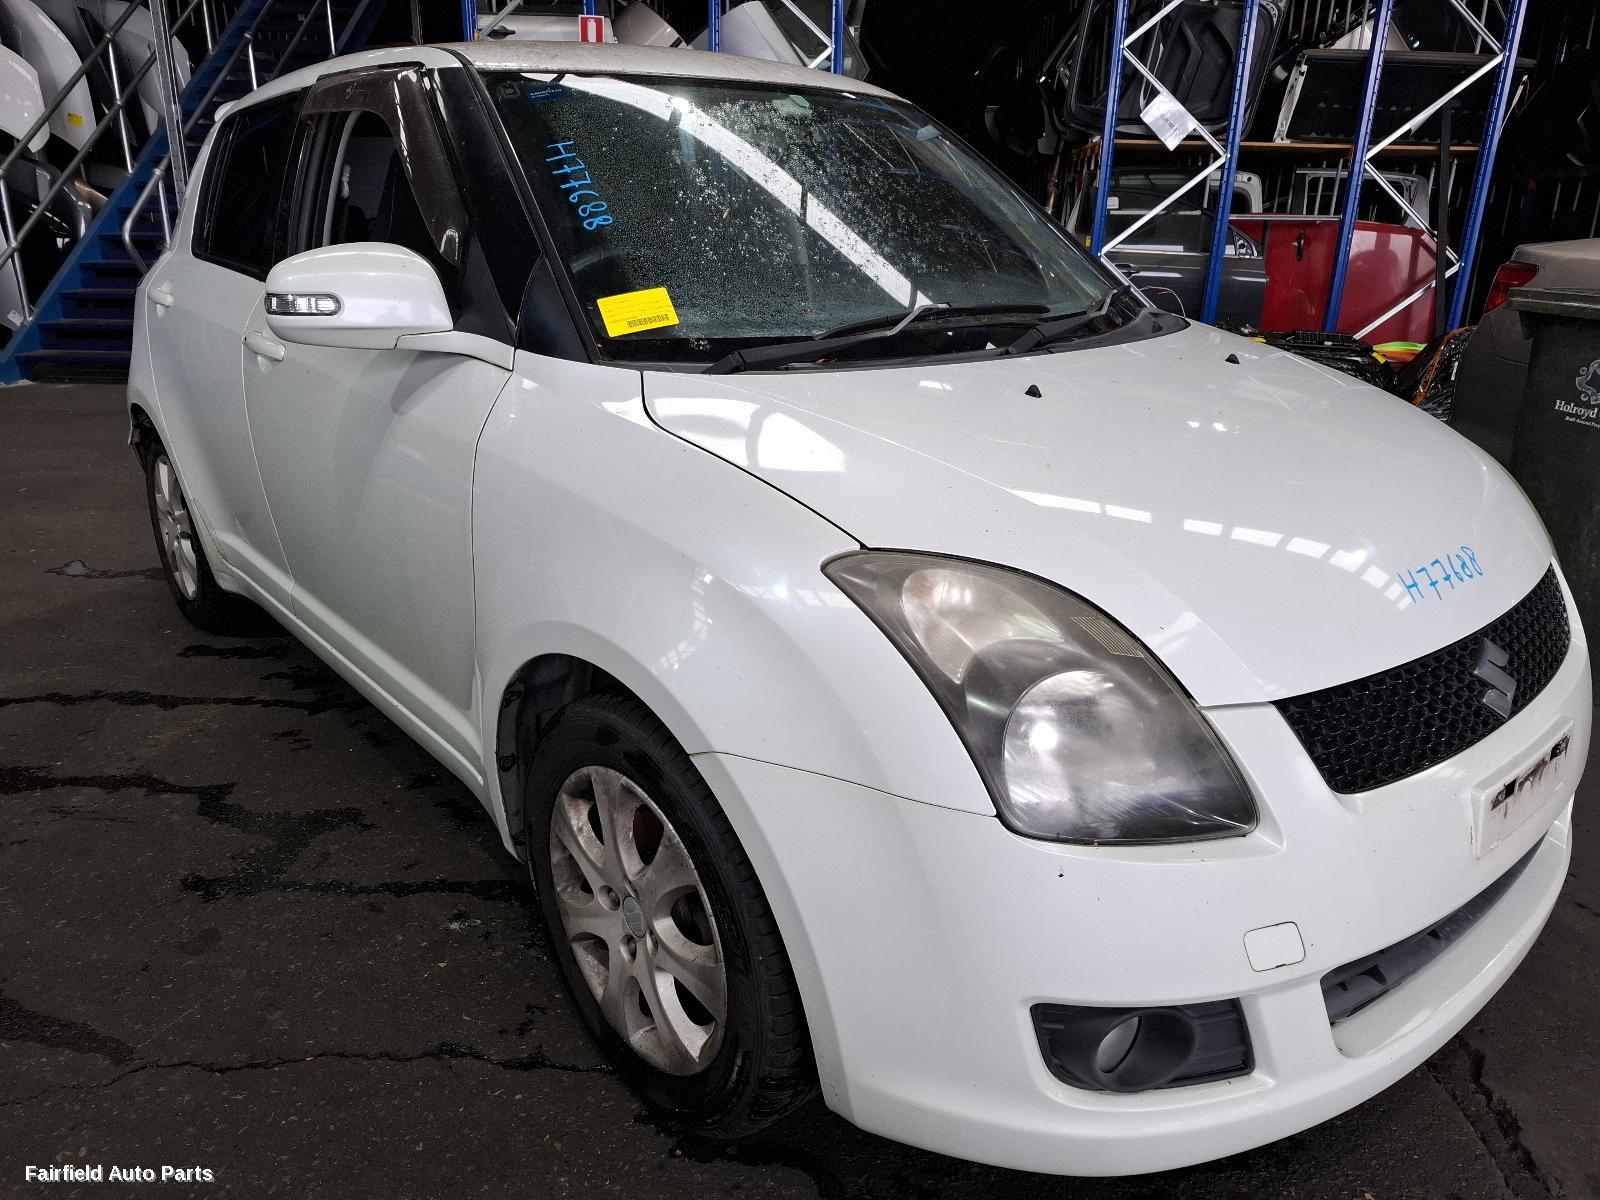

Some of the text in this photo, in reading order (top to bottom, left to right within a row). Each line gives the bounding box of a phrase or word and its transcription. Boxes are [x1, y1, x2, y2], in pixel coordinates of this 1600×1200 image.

[546, 140, 614, 230] H77688
[1554, 399, 1598, 419] Holroyd
[1397, 545, 1484, 604] H77688
